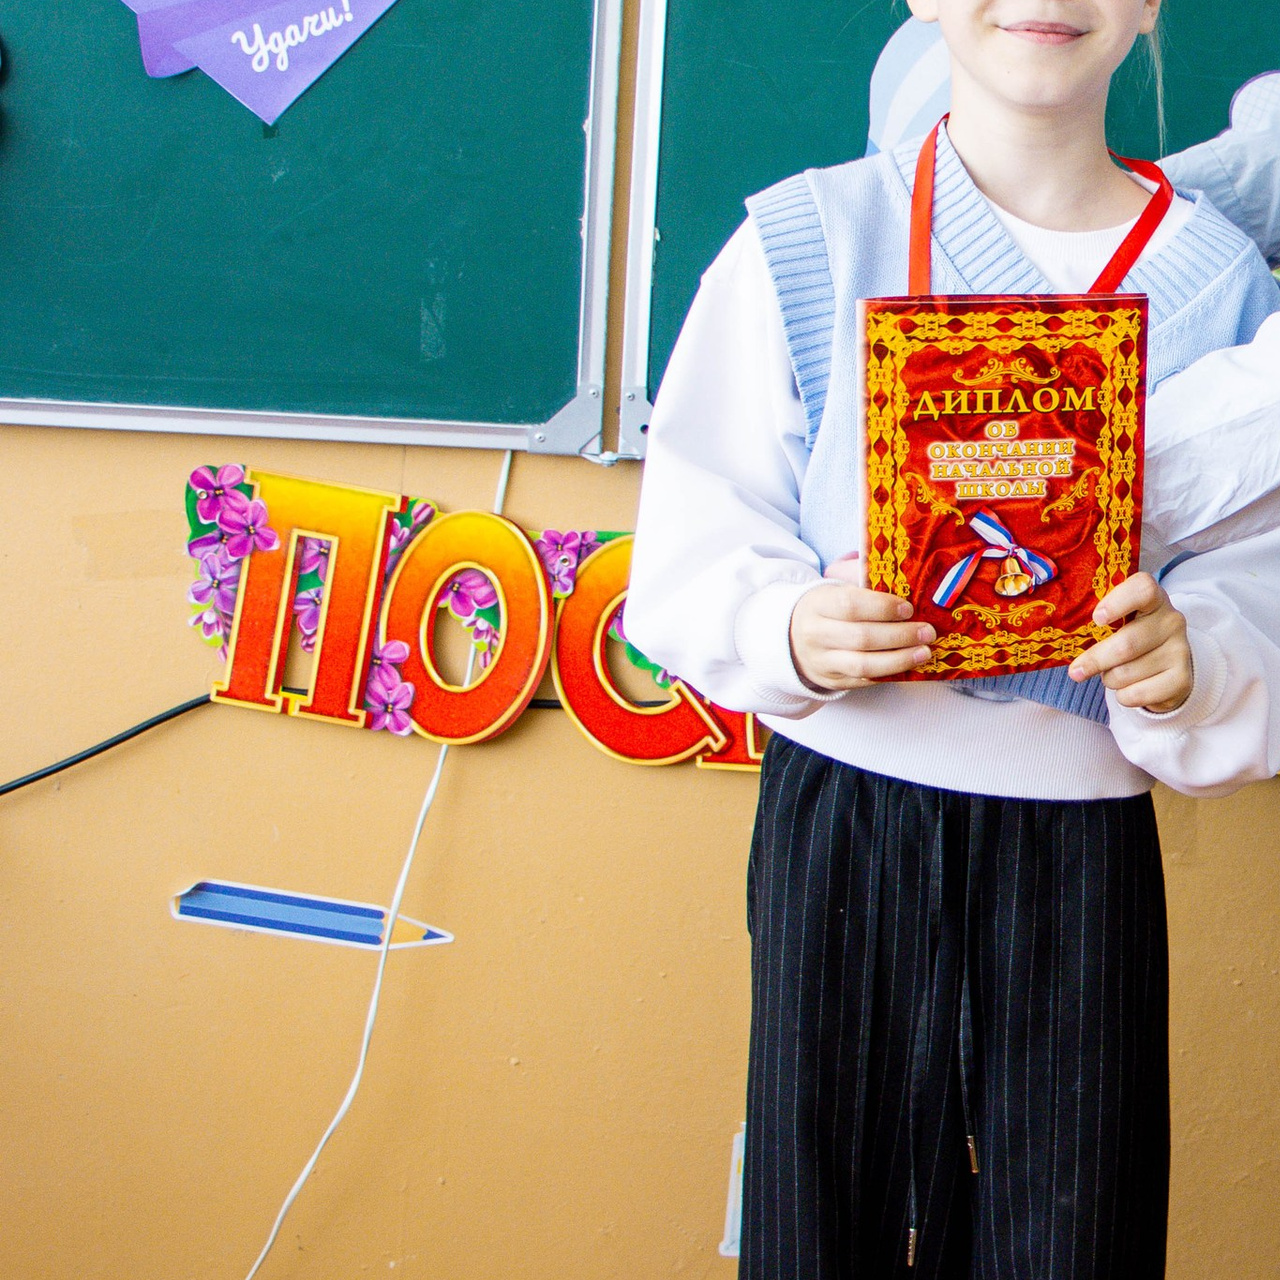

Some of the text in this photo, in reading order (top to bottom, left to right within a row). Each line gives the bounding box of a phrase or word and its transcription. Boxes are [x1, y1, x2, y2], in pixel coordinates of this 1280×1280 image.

[913, 386, 1097, 421] ДИПЛОМ
[986, 422, 1018, 438] ОБ
[929, 440, 1074, 459] ОКОНЧАНИИ
[932, 457, 1072, 479] НАЧАЛЬНОЙ
[957, 481, 1045, 498] ШКОЛЫ
